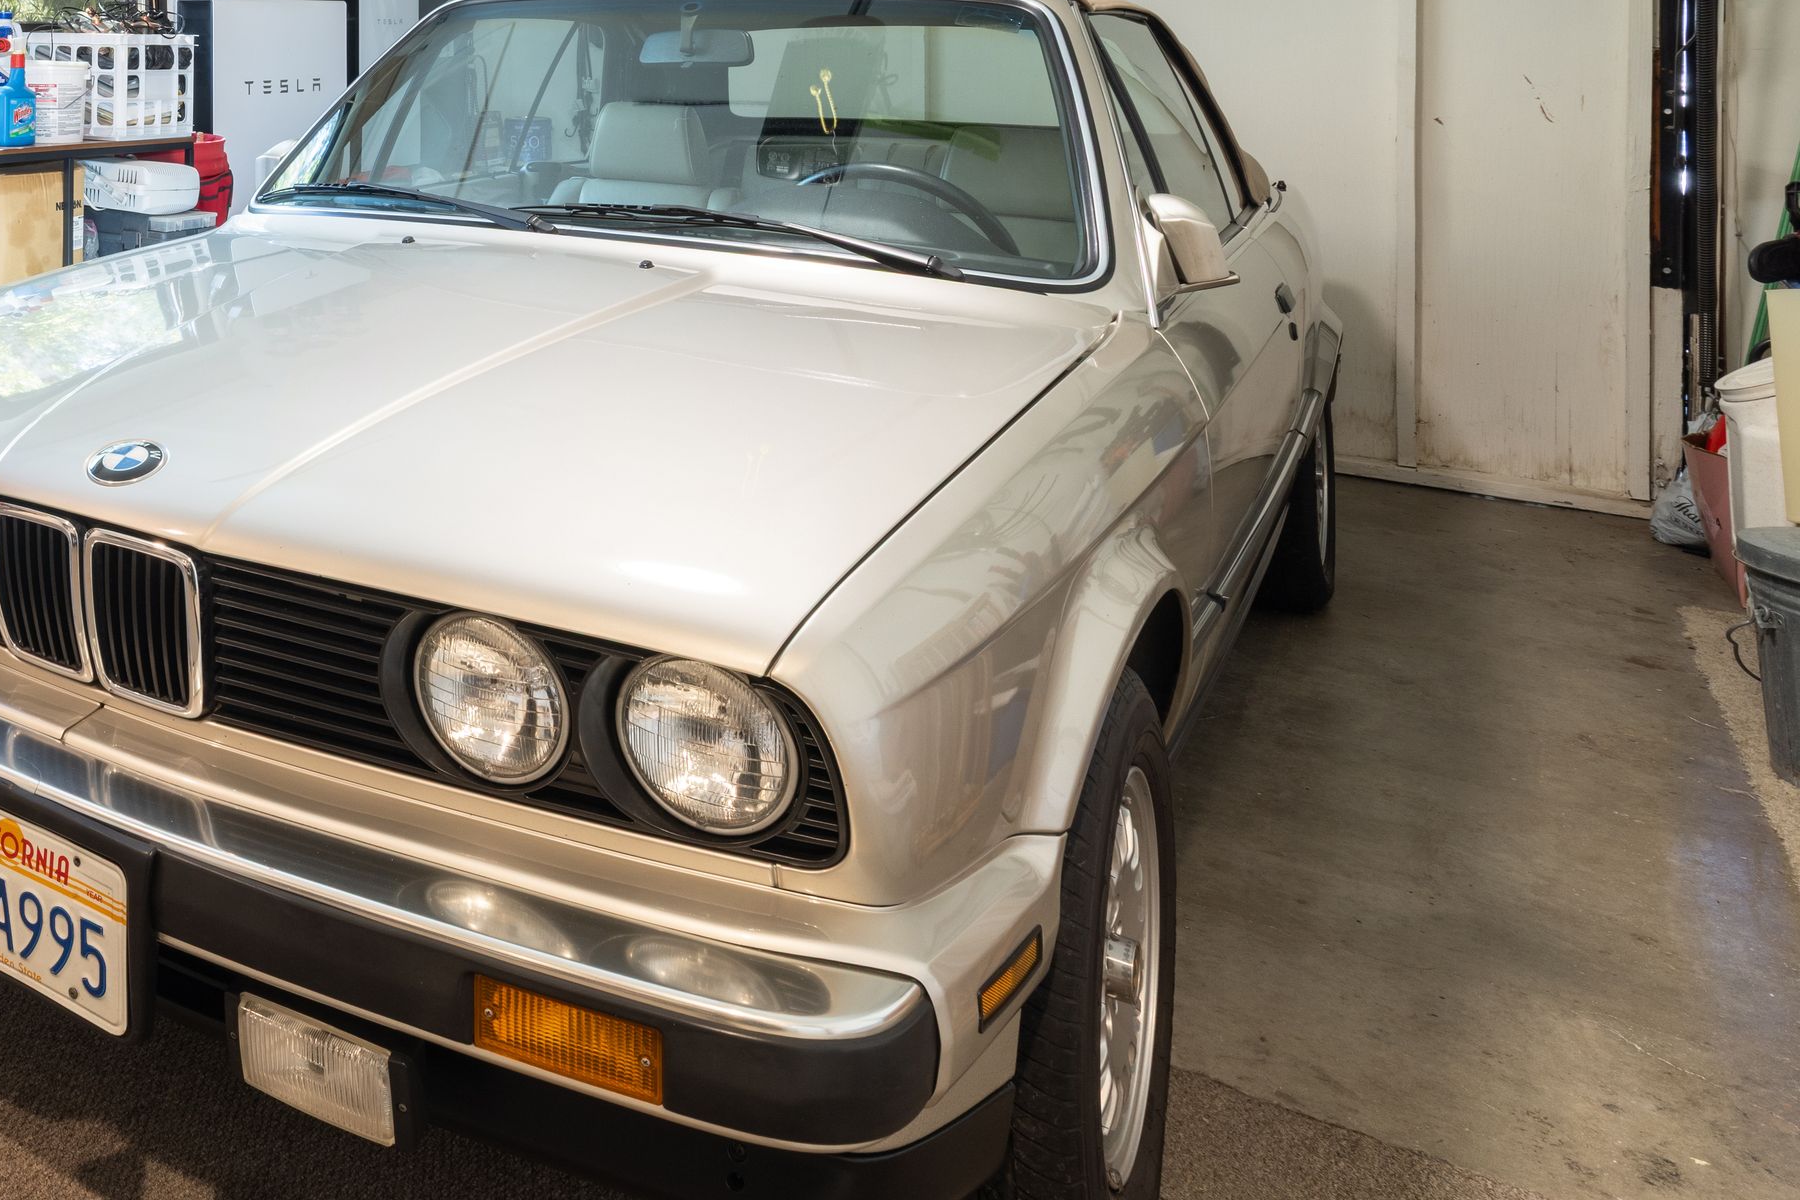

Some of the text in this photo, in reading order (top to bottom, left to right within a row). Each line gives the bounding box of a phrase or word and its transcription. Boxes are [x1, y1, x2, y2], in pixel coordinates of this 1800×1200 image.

[244, 78, 321, 95] TESLA
[86, 888, 103, 903] YEAR
[18, 963, 42, 982] State
